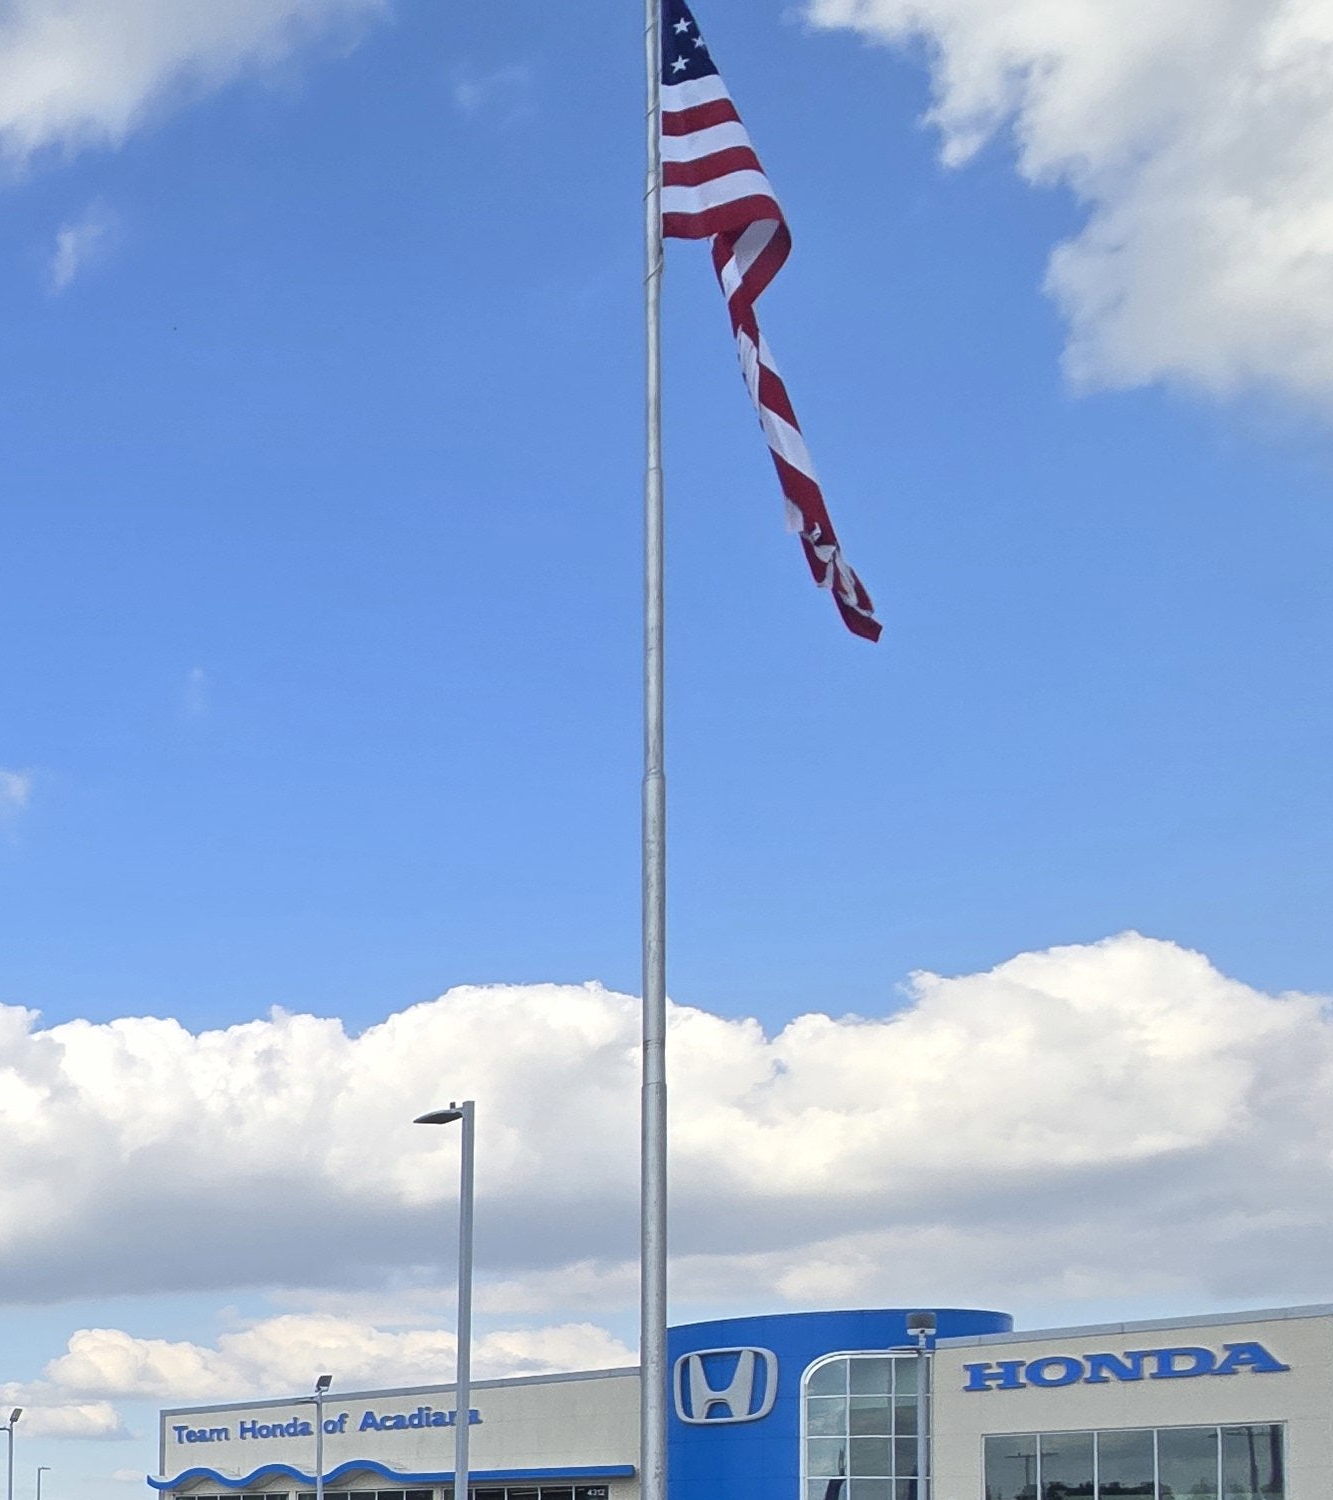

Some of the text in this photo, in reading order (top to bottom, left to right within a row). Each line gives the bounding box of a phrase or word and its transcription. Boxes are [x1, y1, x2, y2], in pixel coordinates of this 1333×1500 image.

[962, 1341, 1290, 1392] HONDA
[172, 1424, 230, 1444] Team
[239, 1416, 314, 1440] Honda
[323, 1412, 349, 1434] of
